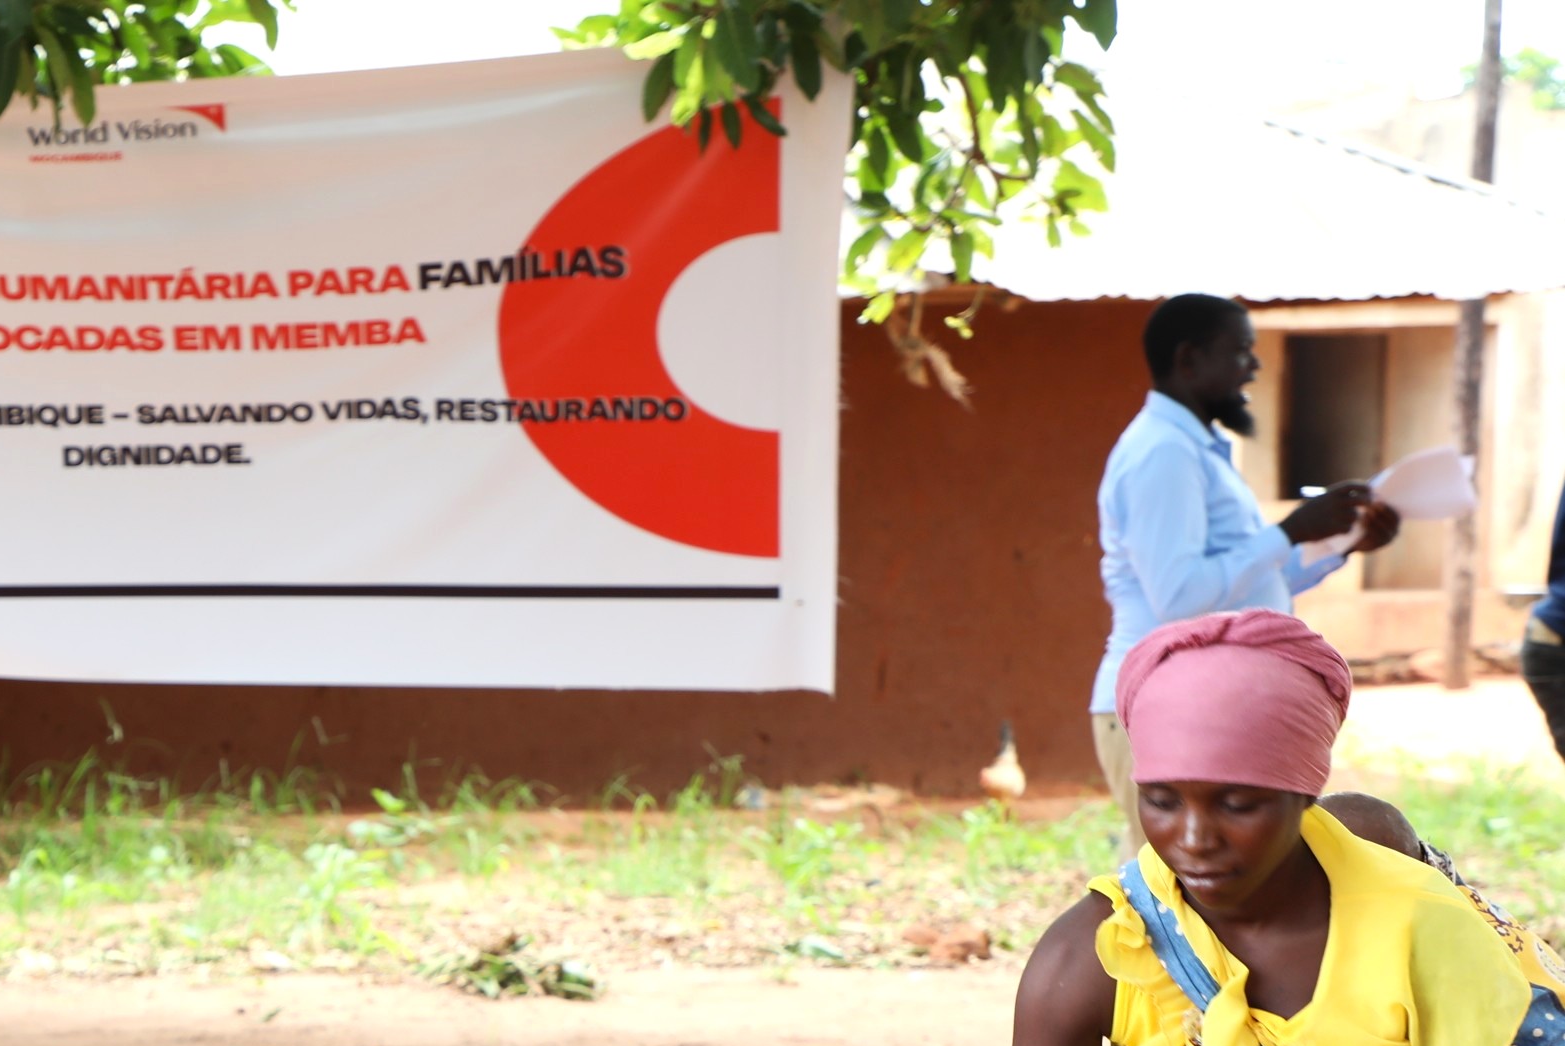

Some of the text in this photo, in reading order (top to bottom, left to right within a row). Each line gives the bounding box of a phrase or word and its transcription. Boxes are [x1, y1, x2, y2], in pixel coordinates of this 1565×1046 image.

[27, 117, 198, 146] World Vision
[288, 265, 411, 298] PARA
[418, 244, 628, 291] FAMÍLIAS
[174, 324, 242, 351] EM
[251, 317, 427, 351] MEMBA
[137, 401, 313, 424] SALVANDO
[321, 397, 429, 425] VIDAS,
[435, 396, 688, 424] RESTAURANDO
[62, 443, 252, 467] DIGNIDADE.
